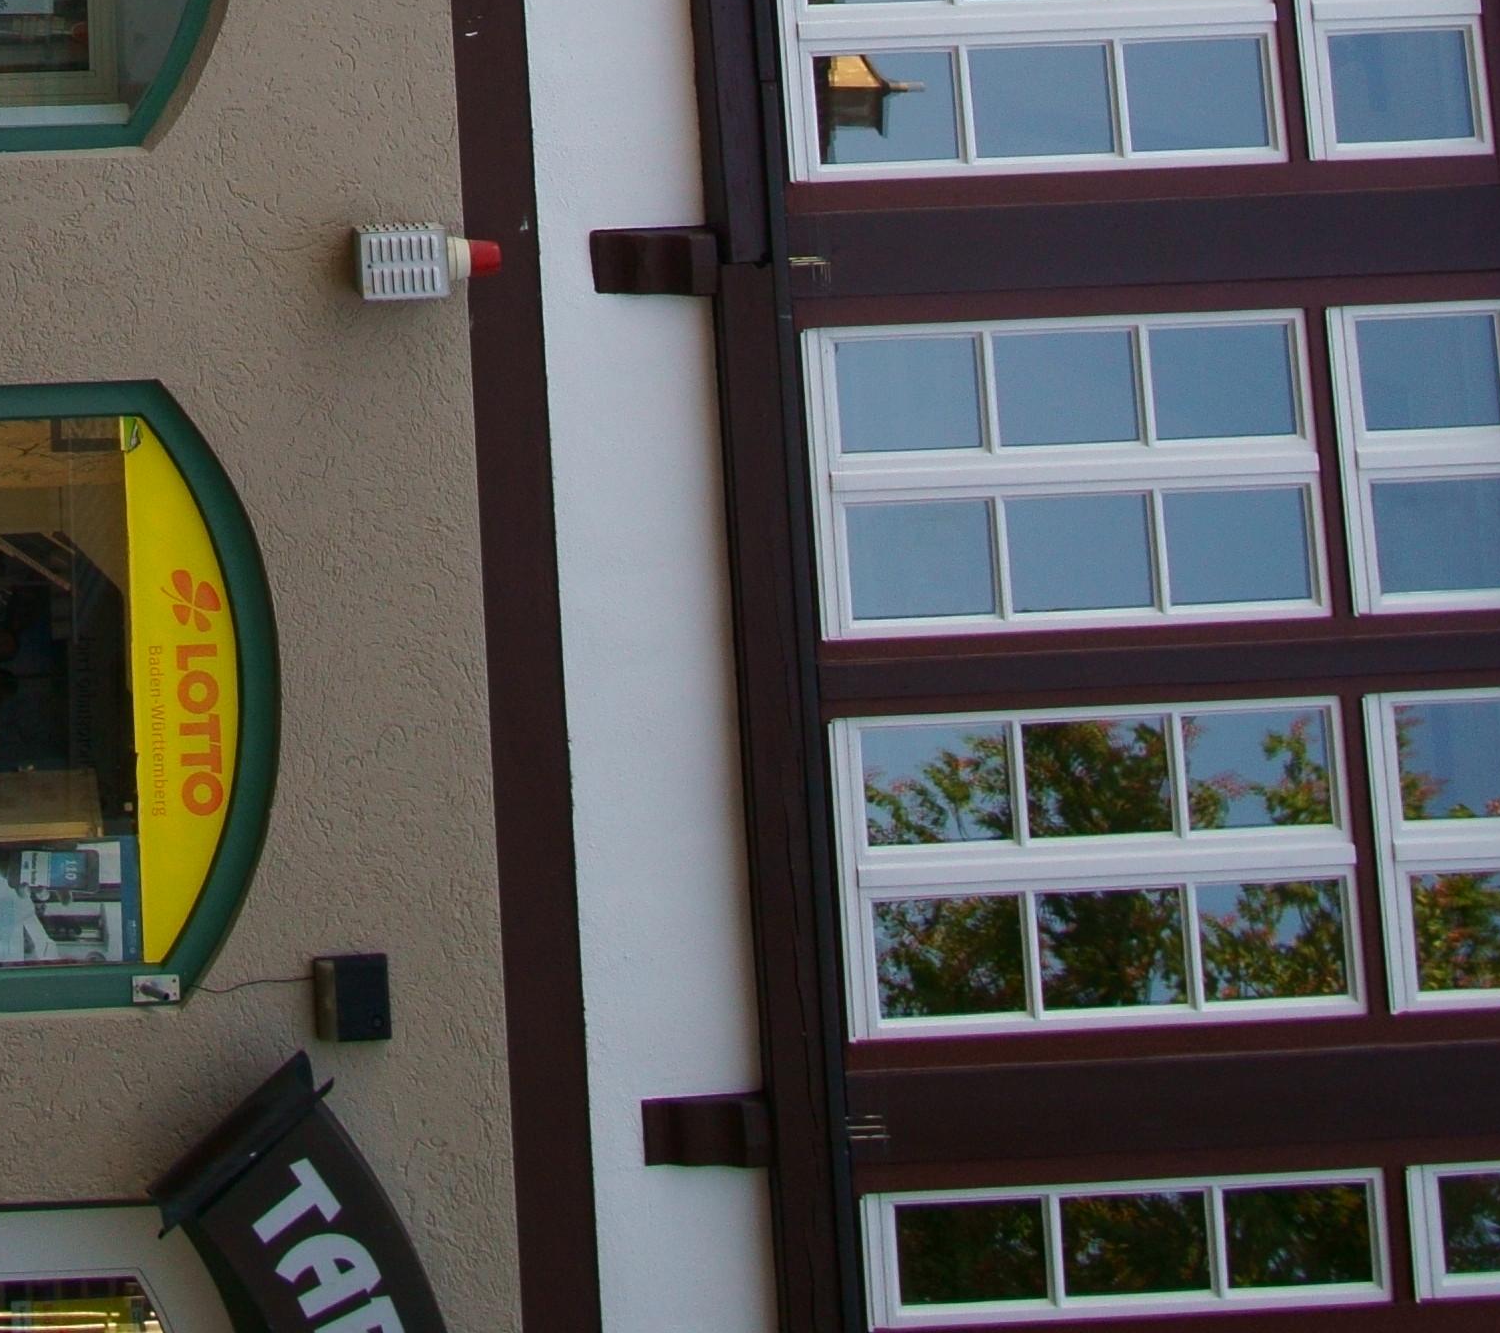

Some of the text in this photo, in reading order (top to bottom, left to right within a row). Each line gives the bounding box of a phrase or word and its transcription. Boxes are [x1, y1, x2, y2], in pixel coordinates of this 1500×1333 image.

[150, 645, 168, 817] Baden-Württemberg
[176, 643, 224, 816] LOTTO
[64, 859, 78, 881] 110
